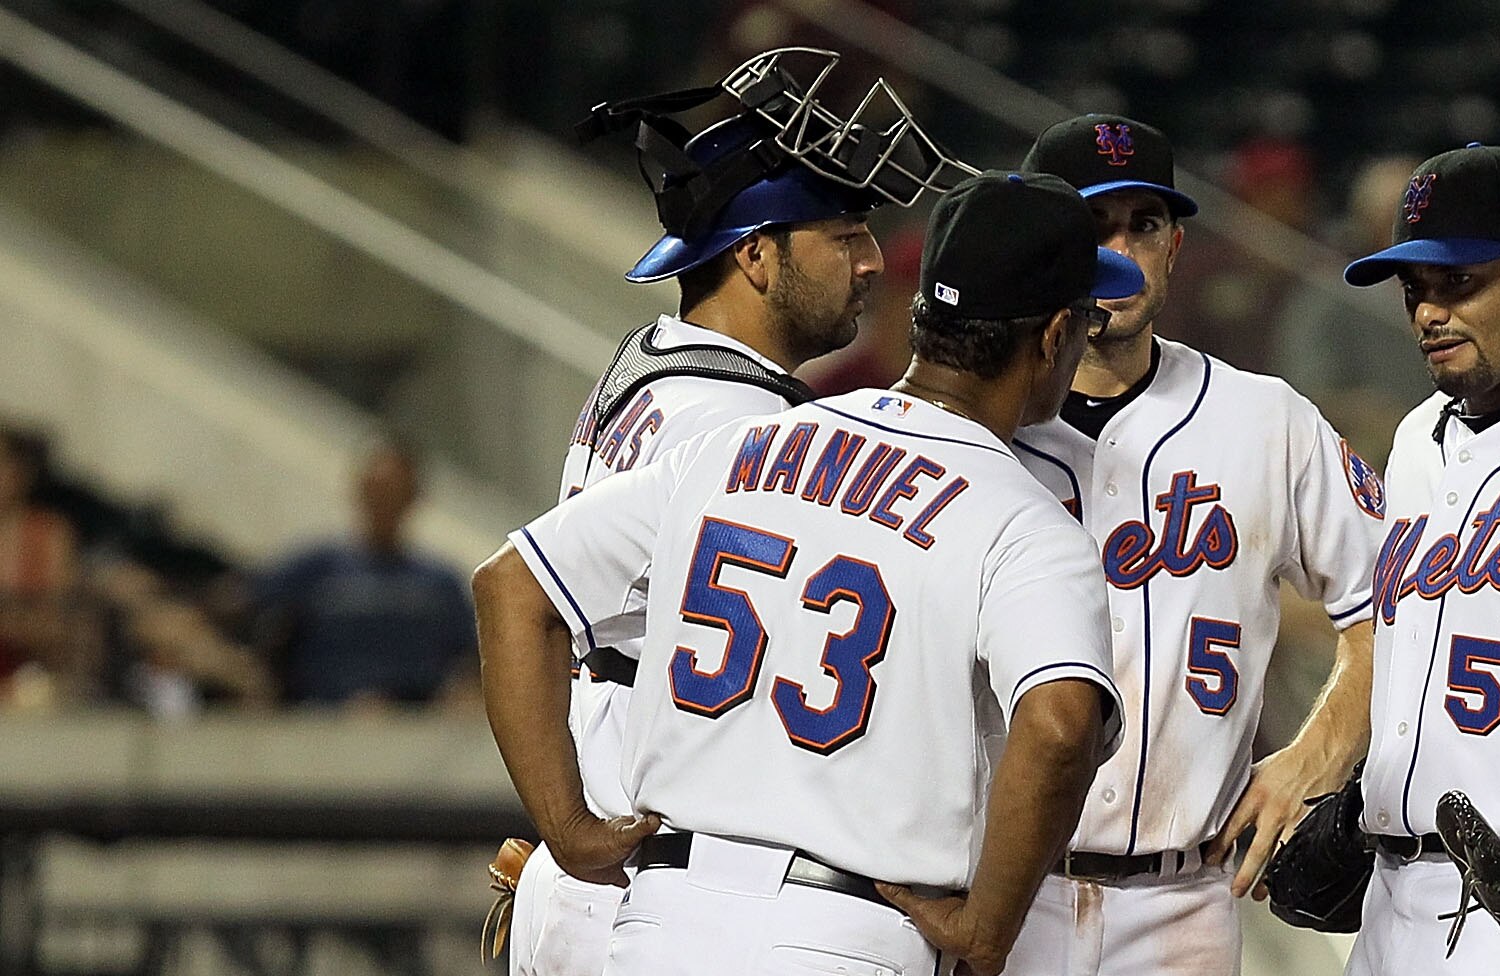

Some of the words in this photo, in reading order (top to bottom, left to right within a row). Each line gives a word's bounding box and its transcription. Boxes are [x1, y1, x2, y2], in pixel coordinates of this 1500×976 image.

[725, 422, 969, 550] MANUEL
[1102, 470, 1239, 590] ets
[669, 516, 897, 755] 53
[1186, 616, 1241, 717] 5
